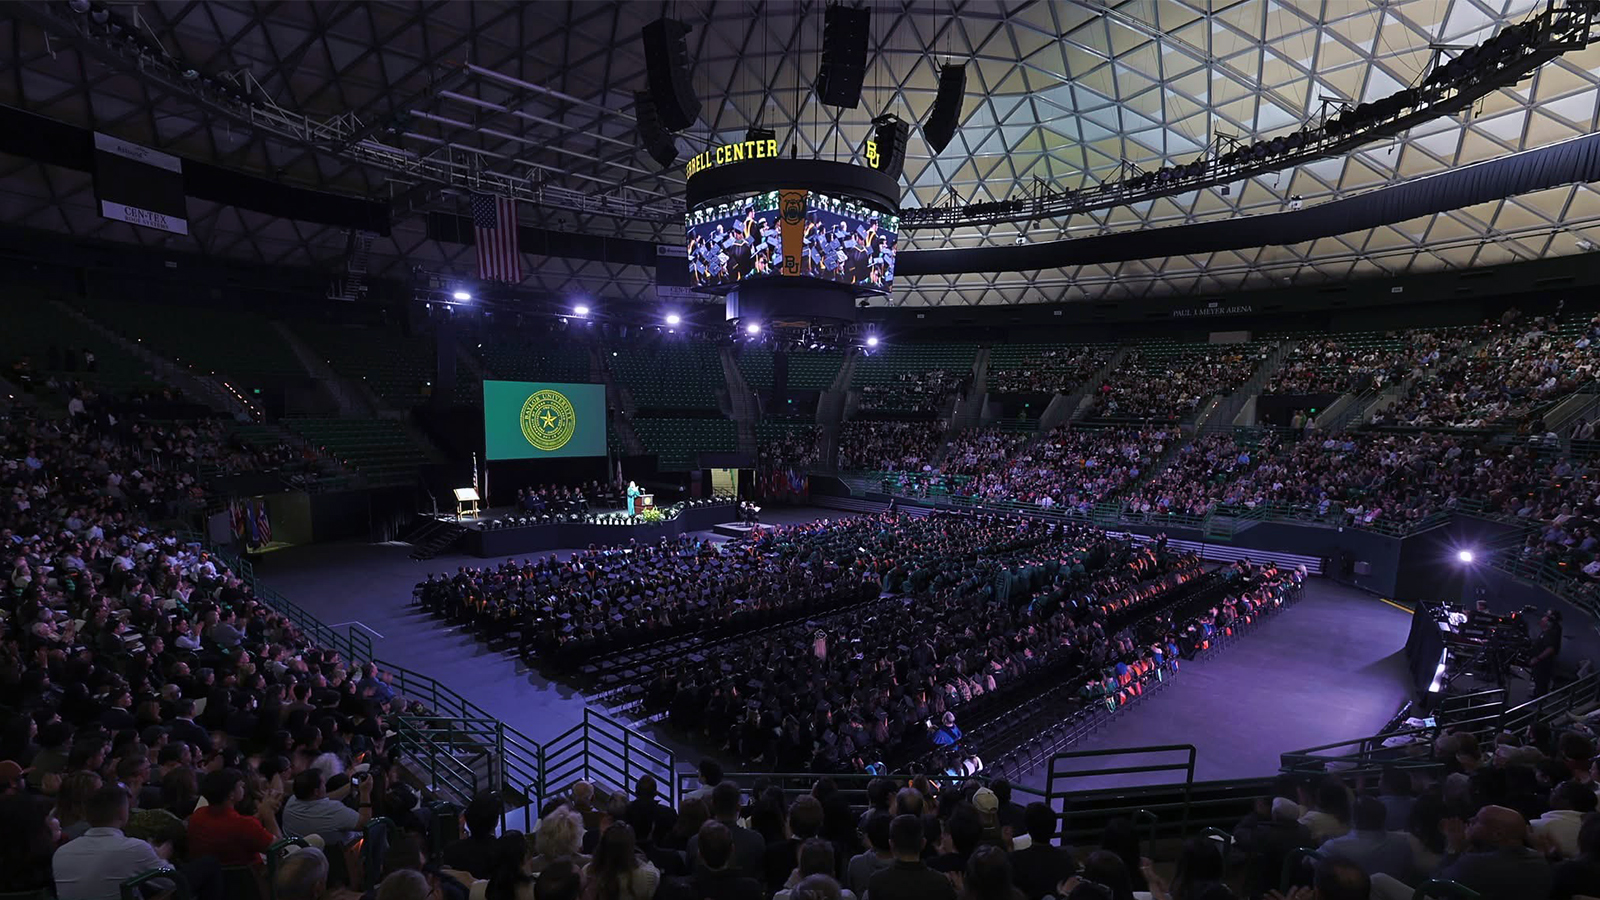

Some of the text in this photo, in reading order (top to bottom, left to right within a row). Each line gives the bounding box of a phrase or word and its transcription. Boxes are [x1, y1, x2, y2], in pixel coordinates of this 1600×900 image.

[716, 139, 778, 165] CENTER
[866, 140, 880, 169] BU
[784, 255, 799, 274] BU
[1173, 309, 1191, 317] PAUL
[1199, 307, 1225, 315] MEYER
[1226, 305, 1252, 314] ARENA
[524, 396, 541, 420] BAYLOR
[542, 393, 573, 420] UNIVERSITY
